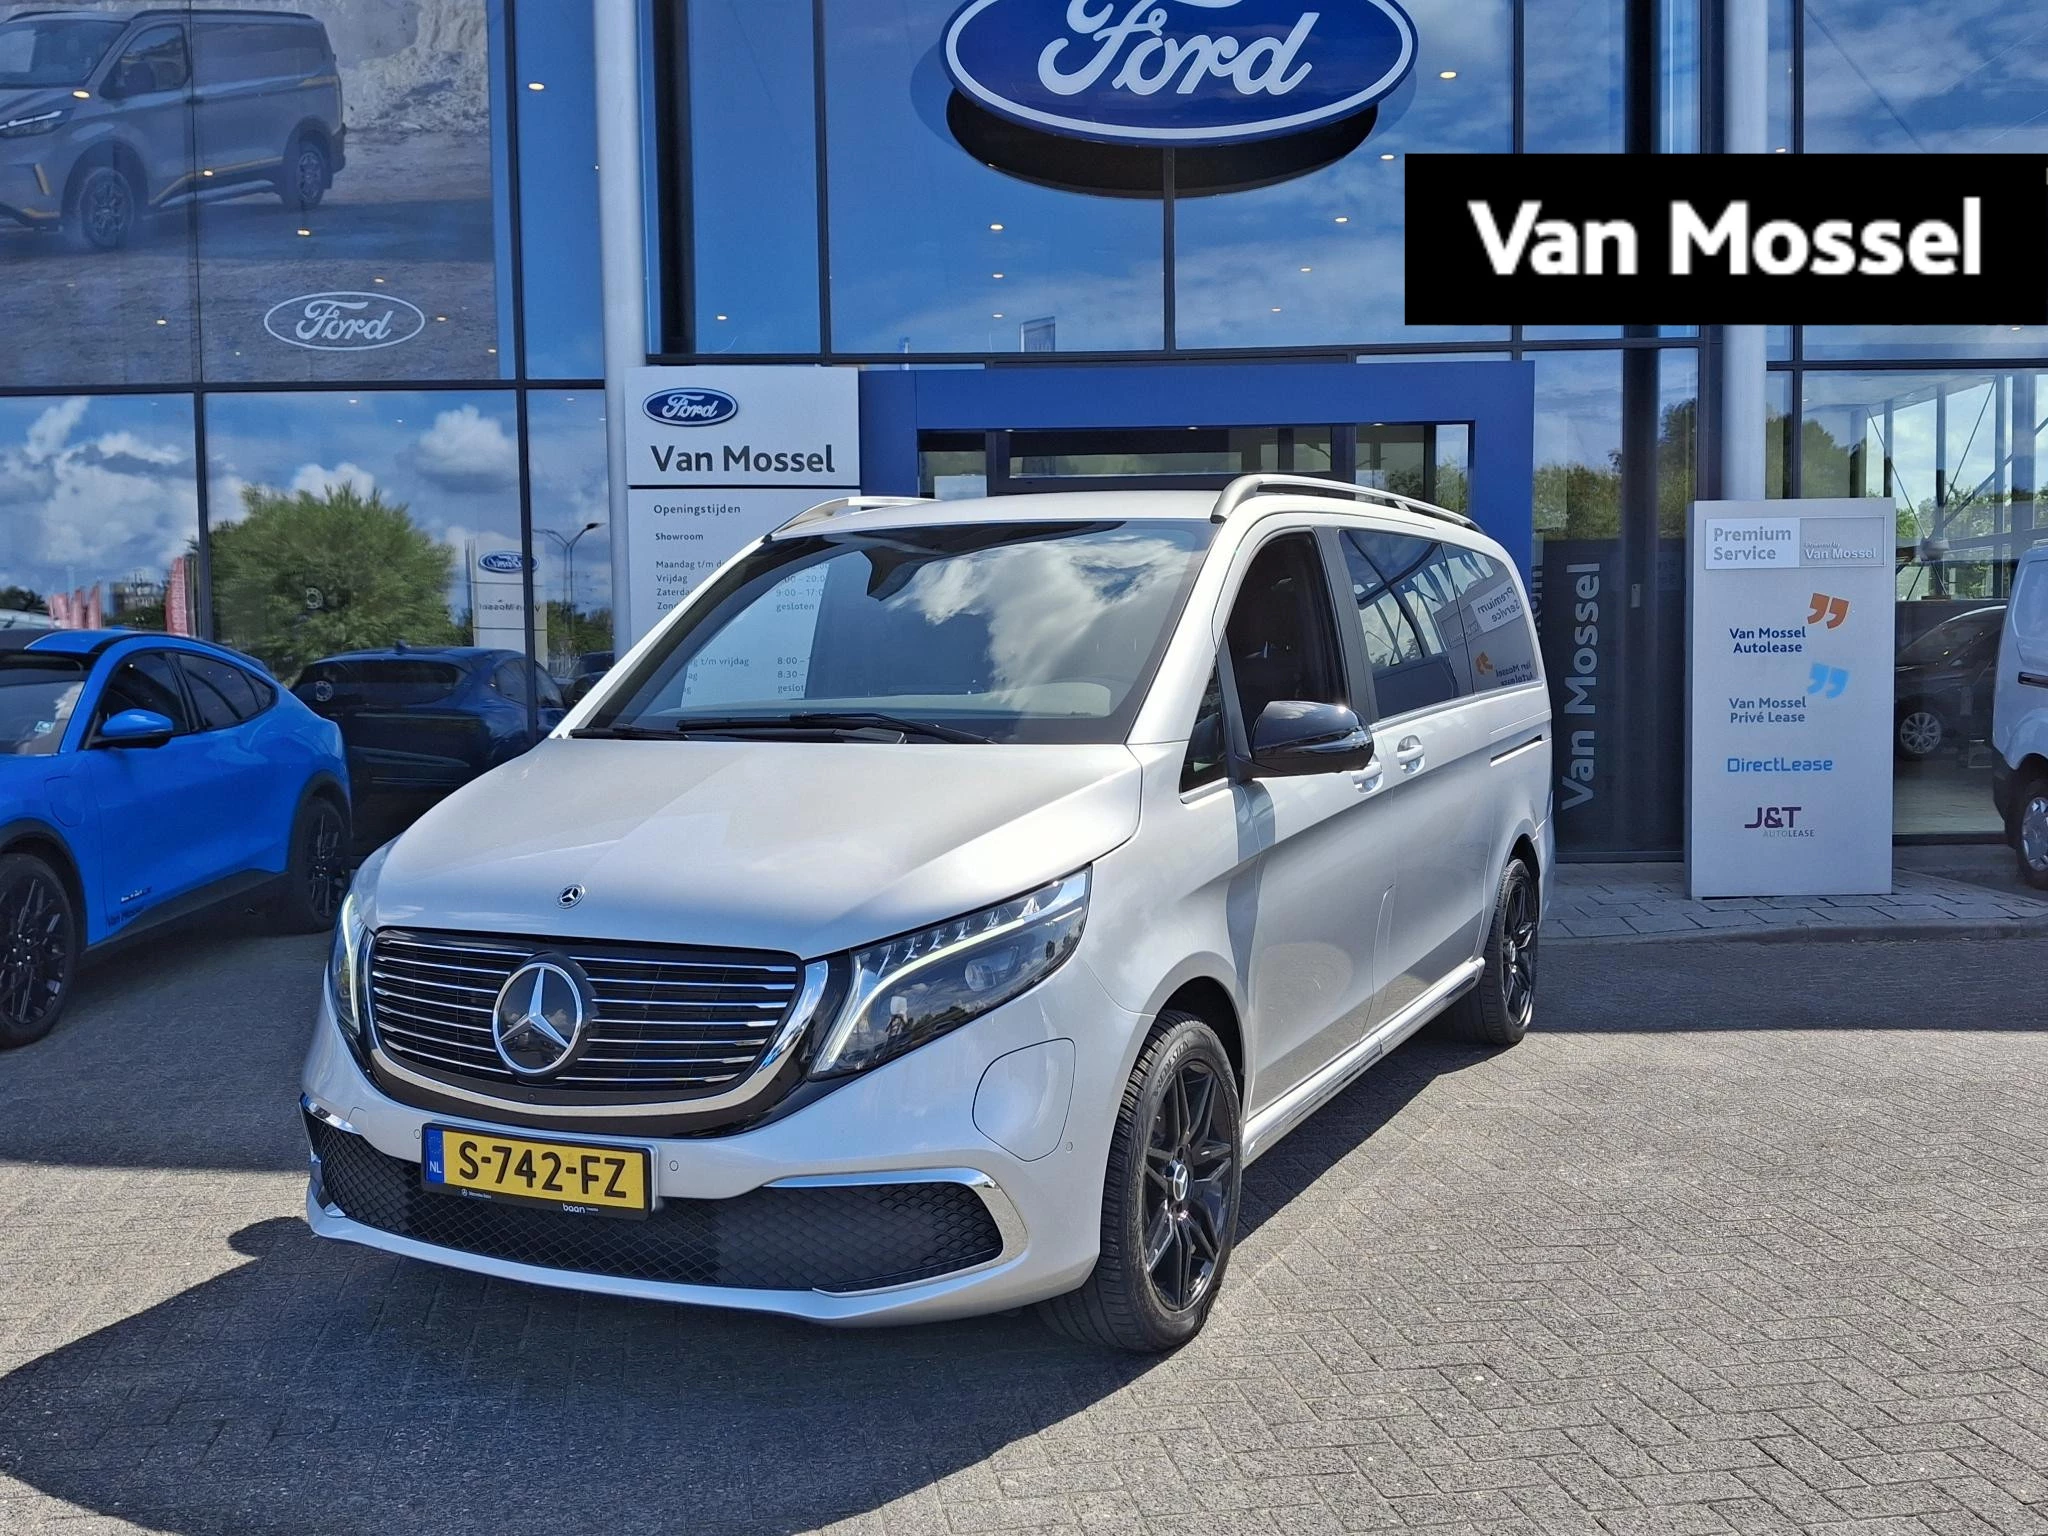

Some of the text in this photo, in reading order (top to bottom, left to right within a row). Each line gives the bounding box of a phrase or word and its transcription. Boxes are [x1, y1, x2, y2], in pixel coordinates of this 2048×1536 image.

[1038, 0, 1320, 96] Ford
[296, 299, 393, 342] Ford
[661, 394, 719, 418] Ford
[650, 444, 835, 473] Van Mossel
[653, 504, 741, 516] Openingstijden
[655, 532, 704, 541] Showroom
[1713, 526, 1791, 542] Premium
[1713, 545, 1776, 561] Service
[1804, 547, 1876, 560] Van Mossel
[656, 560, 695, 571] Maandag
[697, 560, 714, 568] t/m
[656, 575, 688, 585] Vrijdag
[656, 588, 693, 597] Zaterda
[776, 603, 815, 613] gesloten
[1729, 626, 1807, 640] Van Mossel
[1733, 641, 1803, 653] Autolease
[719, 656, 750, 667] vrijdag
[777, 656, 797, 665] 8:00
[777, 670, 797, 679] 8:30
[1562, 563, 1601, 810] Van Mossel
[1729, 696, 1807, 709] Van Mossel
[1730, 711, 1805, 723] Privé Lease
[1727, 757, 1833, 772] DirectLease
[1744, 806, 1802, 828] J&T
[1762, 829, 1815, 838] AUTOLEASE
[429, 1140, 627, 1199] NL S-742-FZ
[562, 1203, 586, 1214] baan
